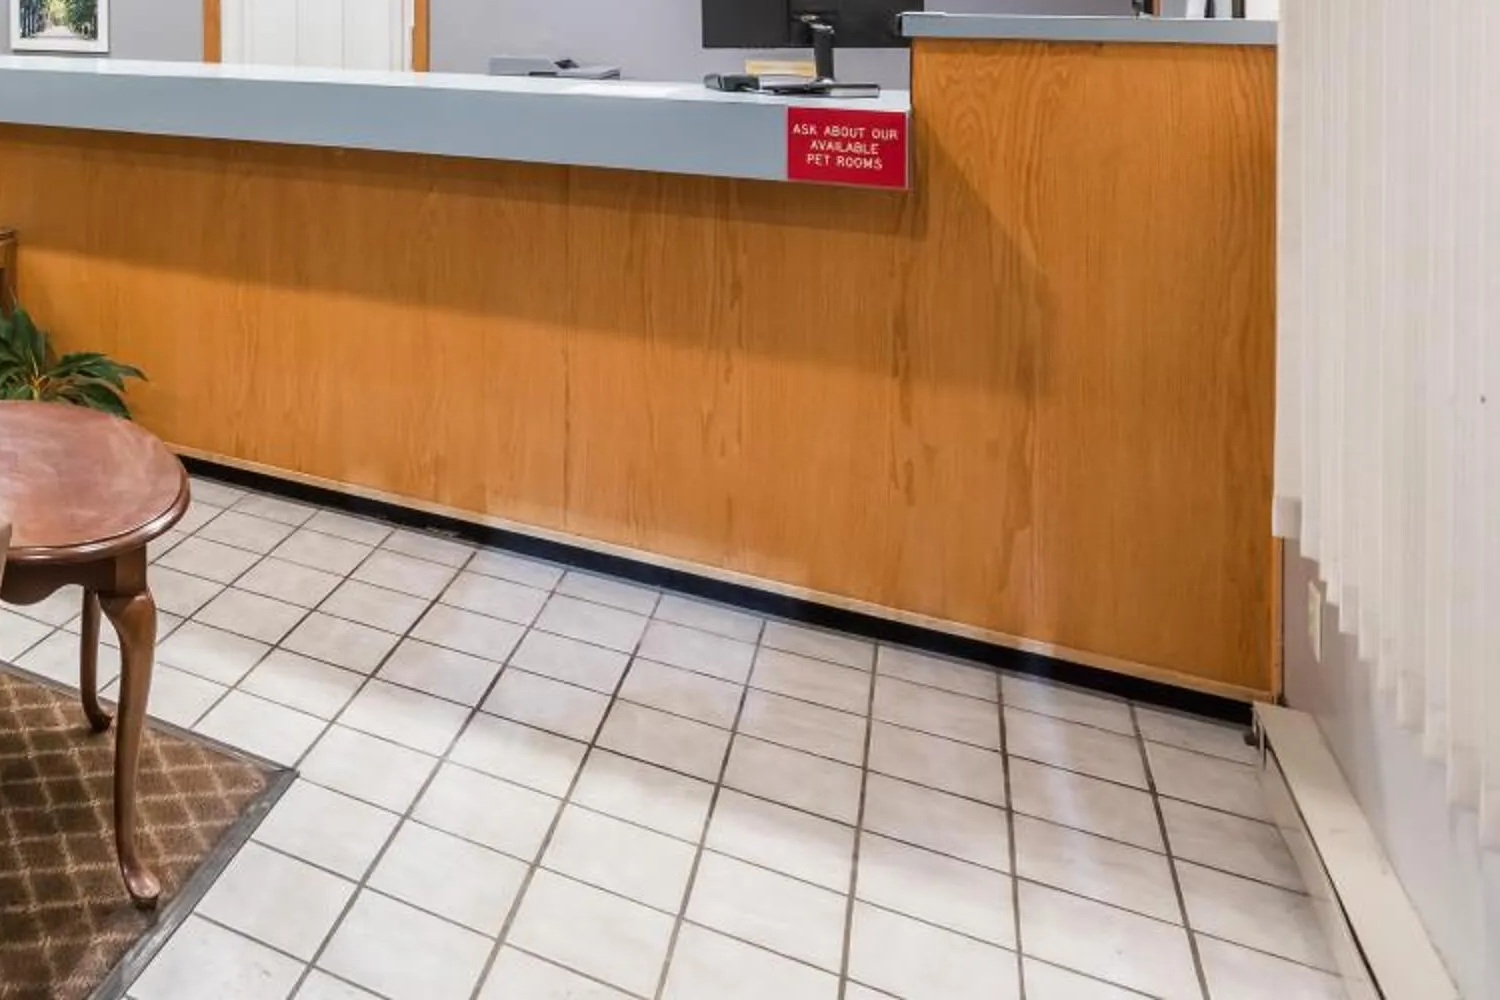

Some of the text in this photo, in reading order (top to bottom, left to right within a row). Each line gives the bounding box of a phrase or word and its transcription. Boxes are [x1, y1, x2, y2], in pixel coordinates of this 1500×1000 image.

[793, 123, 898, 140] ASK ABOUT OUR
[810, 140, 880, 155] AVAILABLE
[807, 153, 883, 170] PET ROOMS
